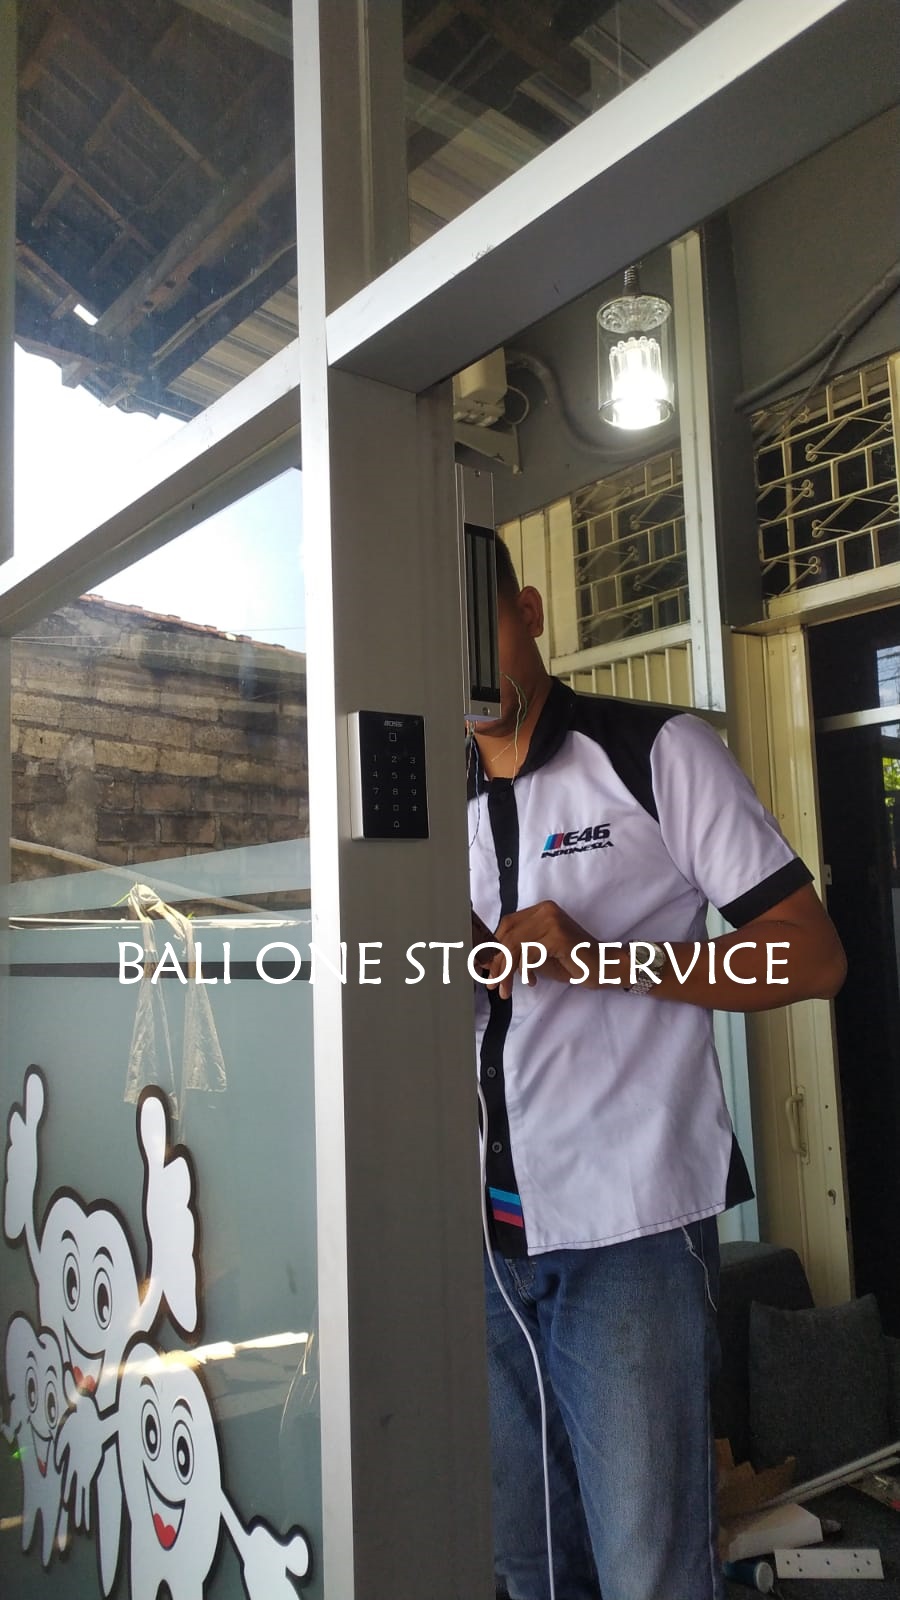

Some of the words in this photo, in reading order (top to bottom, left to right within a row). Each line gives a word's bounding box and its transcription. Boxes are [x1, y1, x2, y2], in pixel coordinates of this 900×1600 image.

[391, 755, 398, 763] 2
[372, 770, 378, 778] 4
[563, 823, 610, 847] E46
